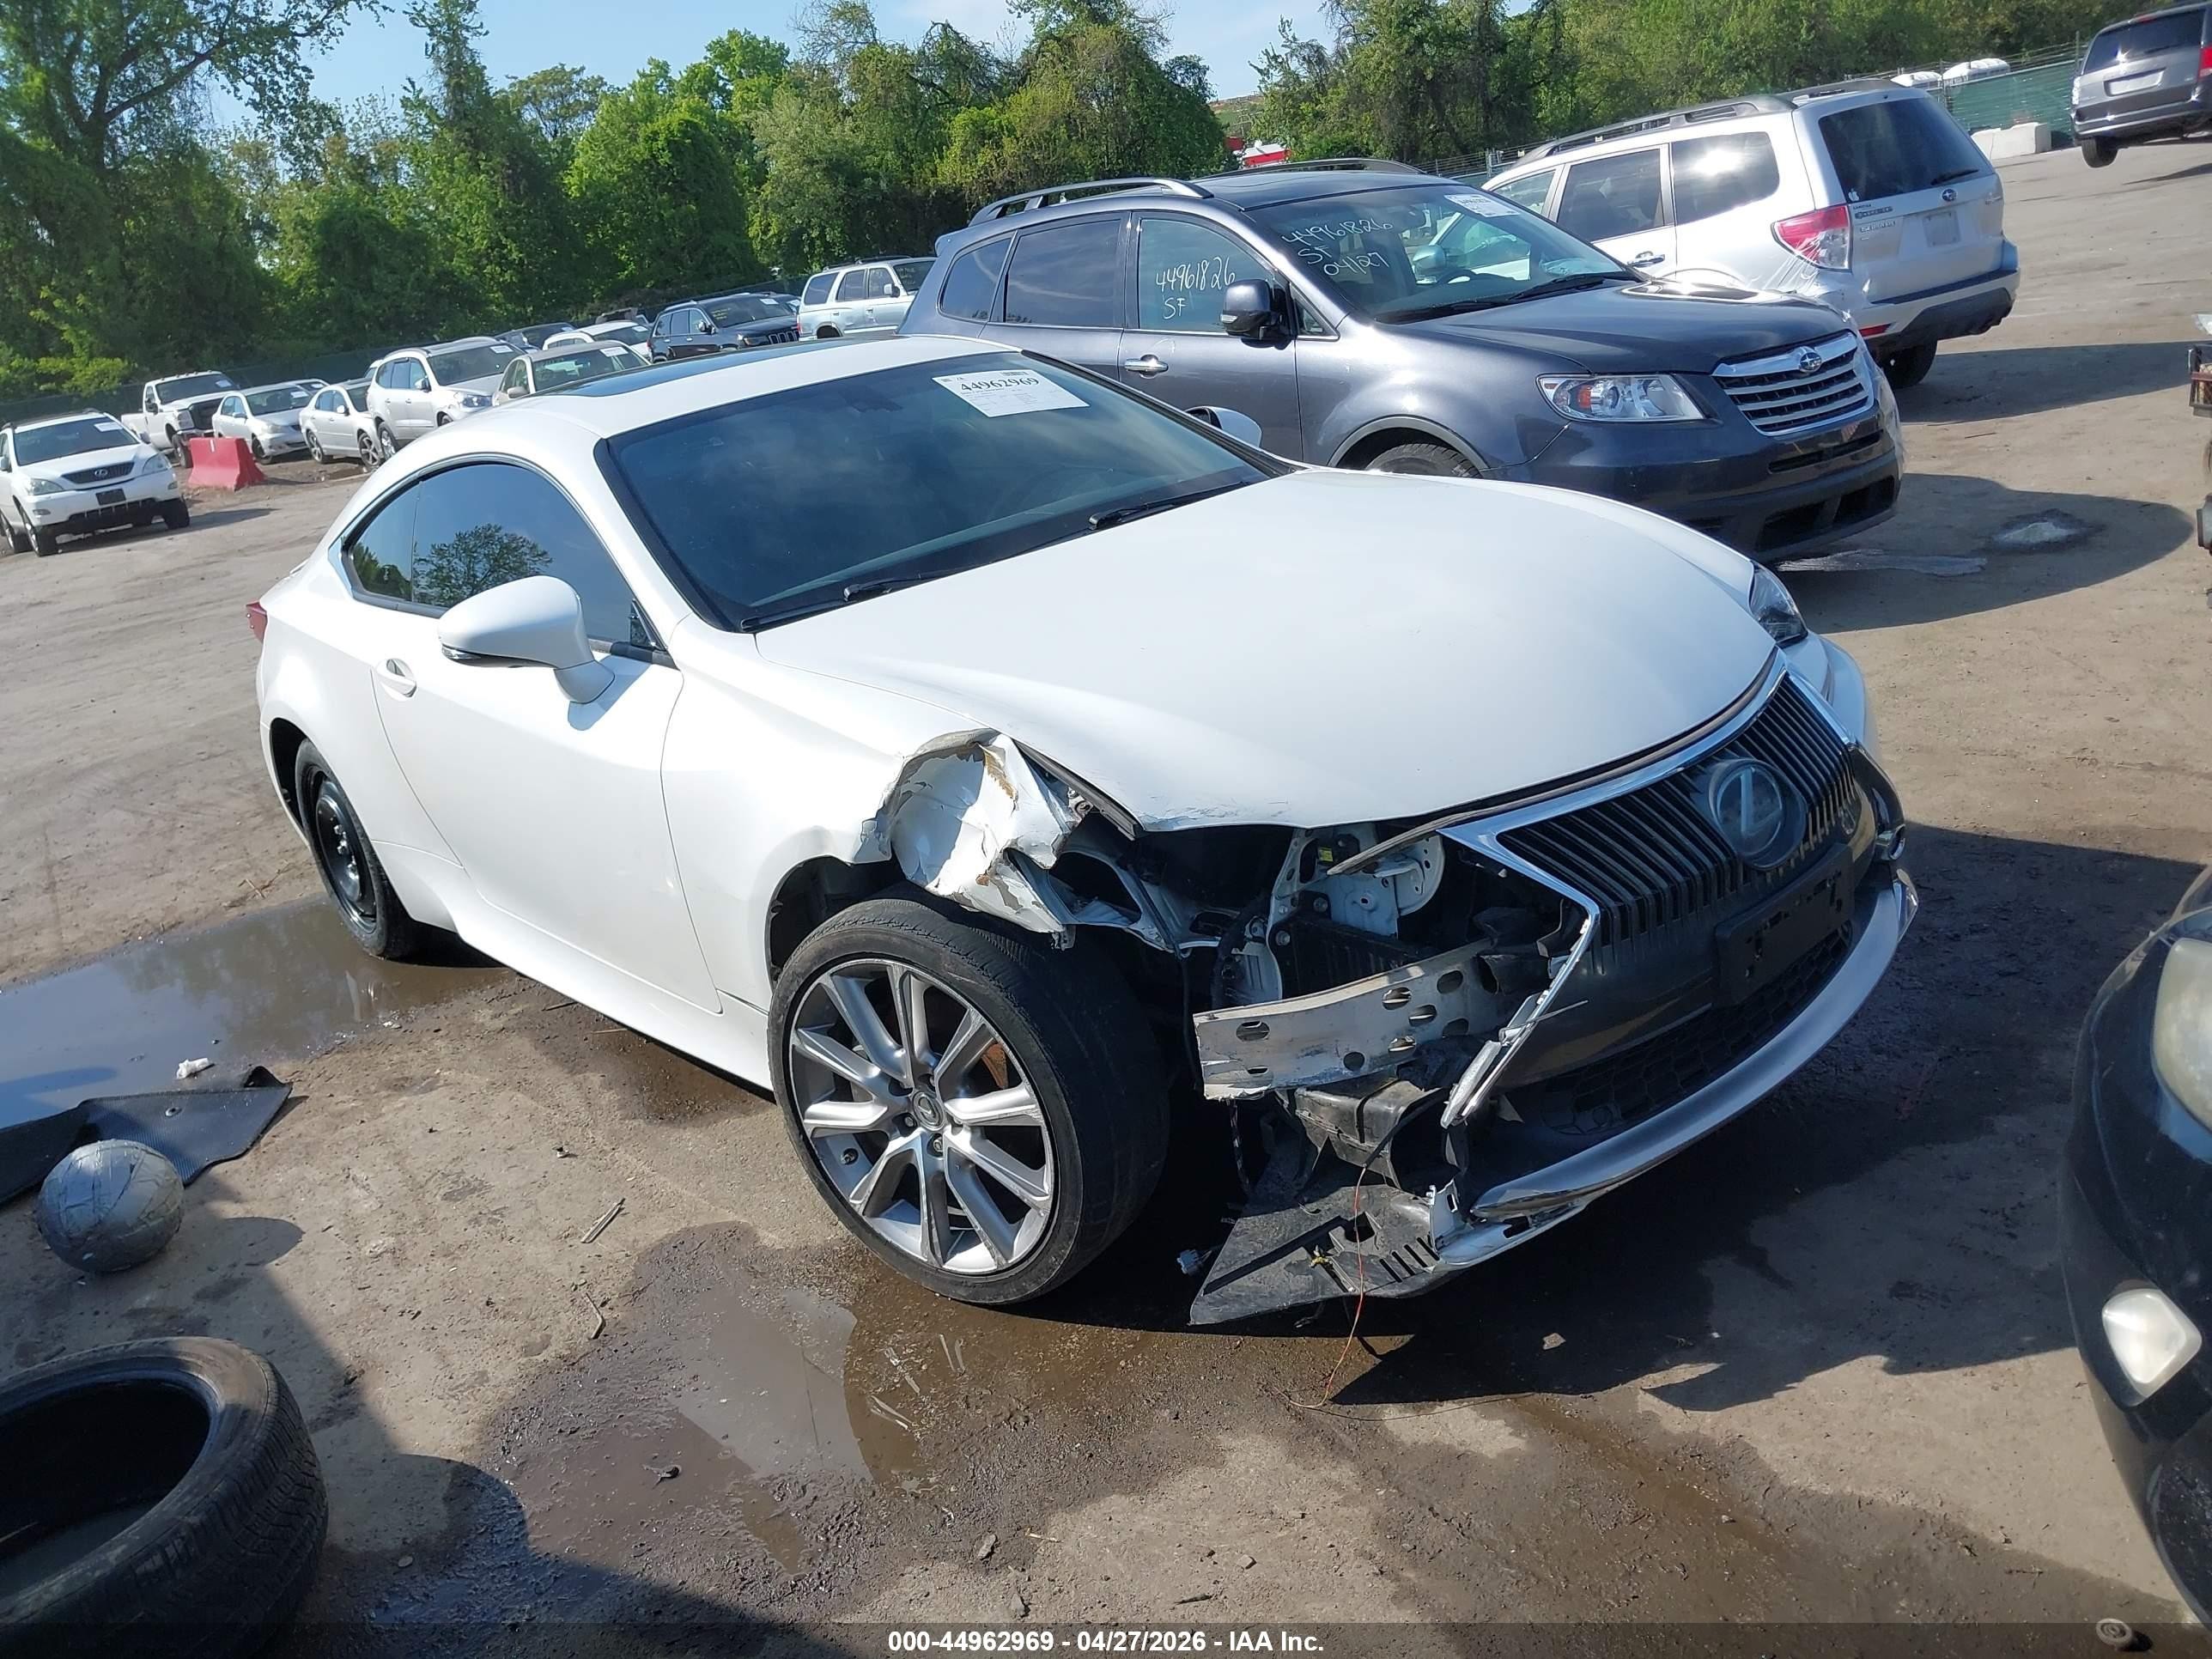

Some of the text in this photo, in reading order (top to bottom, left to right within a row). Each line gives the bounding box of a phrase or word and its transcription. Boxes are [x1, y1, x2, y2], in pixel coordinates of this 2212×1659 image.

[1282, 218, 1394, 246] 44961826
[1297, 245, 1330, 264] SF
[1156, 257, 1236, 292] 44961826
[1163, 298, 1187, 319] SF
[961, 378, 1039, 391] 44962969
